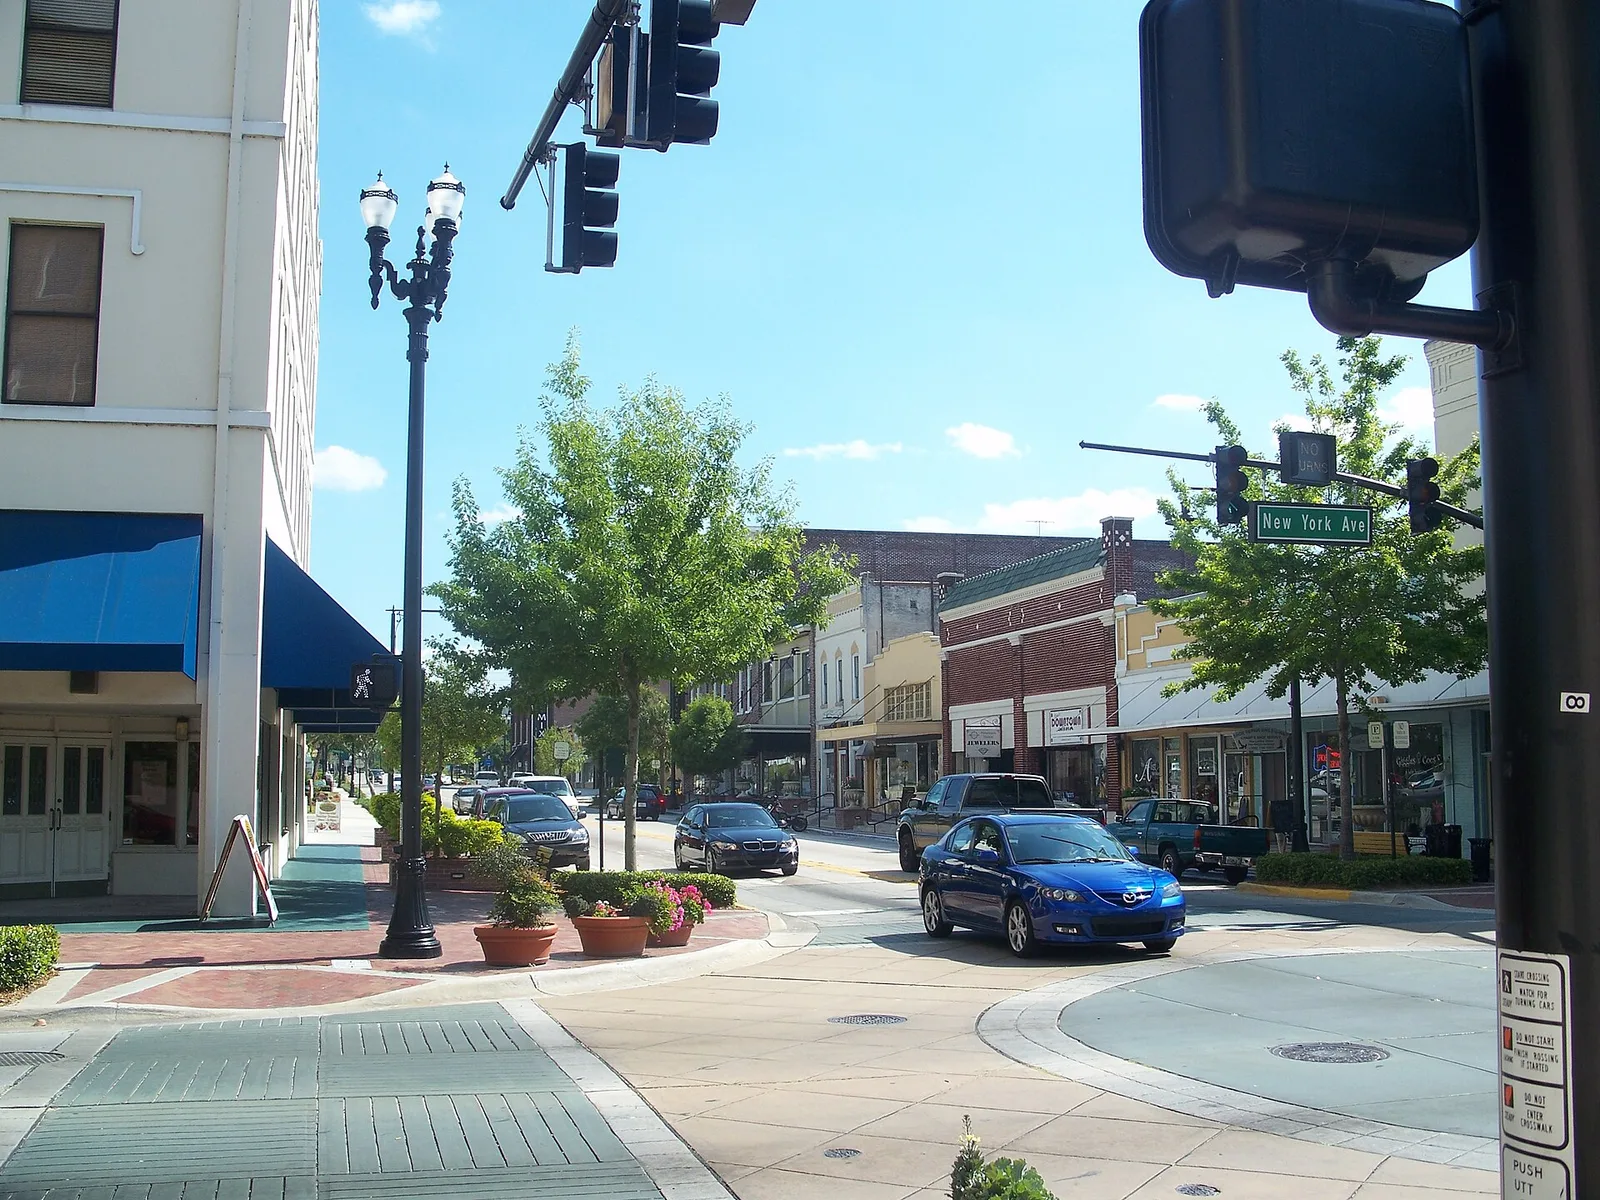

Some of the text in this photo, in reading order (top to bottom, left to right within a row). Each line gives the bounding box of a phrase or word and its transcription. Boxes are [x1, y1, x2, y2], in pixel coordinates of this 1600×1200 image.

[1301, 442, 1318, 456] NO
[1299, 459, 1328, 474] URNS
[1263, 512, 1365, 533] New York Ave
[1051, 716, 1082, 728] DOWNTOWN
[1527, 972, 1549, 982] CROSSING
[1520, 988, 1548, 1000] WATCH FOR
[1515, 997, 1554, 1011] TURNING CARS
[1516, 1032, 1554, 1046] DO NOT START
[1514, 1048, 1528, 1059] FINISH
[1533, 1052, 1559, 1063] ROSSING
[1521, 1060, 1549, 1072] IF STARTED
[1524, 1092, 1545, 1105] DO NOT
[1527, 1110, 1543, 1121] ENTER
[1521, 1118, 1552, 1133] CROSSWALK
[1513, 1159, 1543, 1179] PUSH
[1514, 1178, 1534, 1196] UTT
